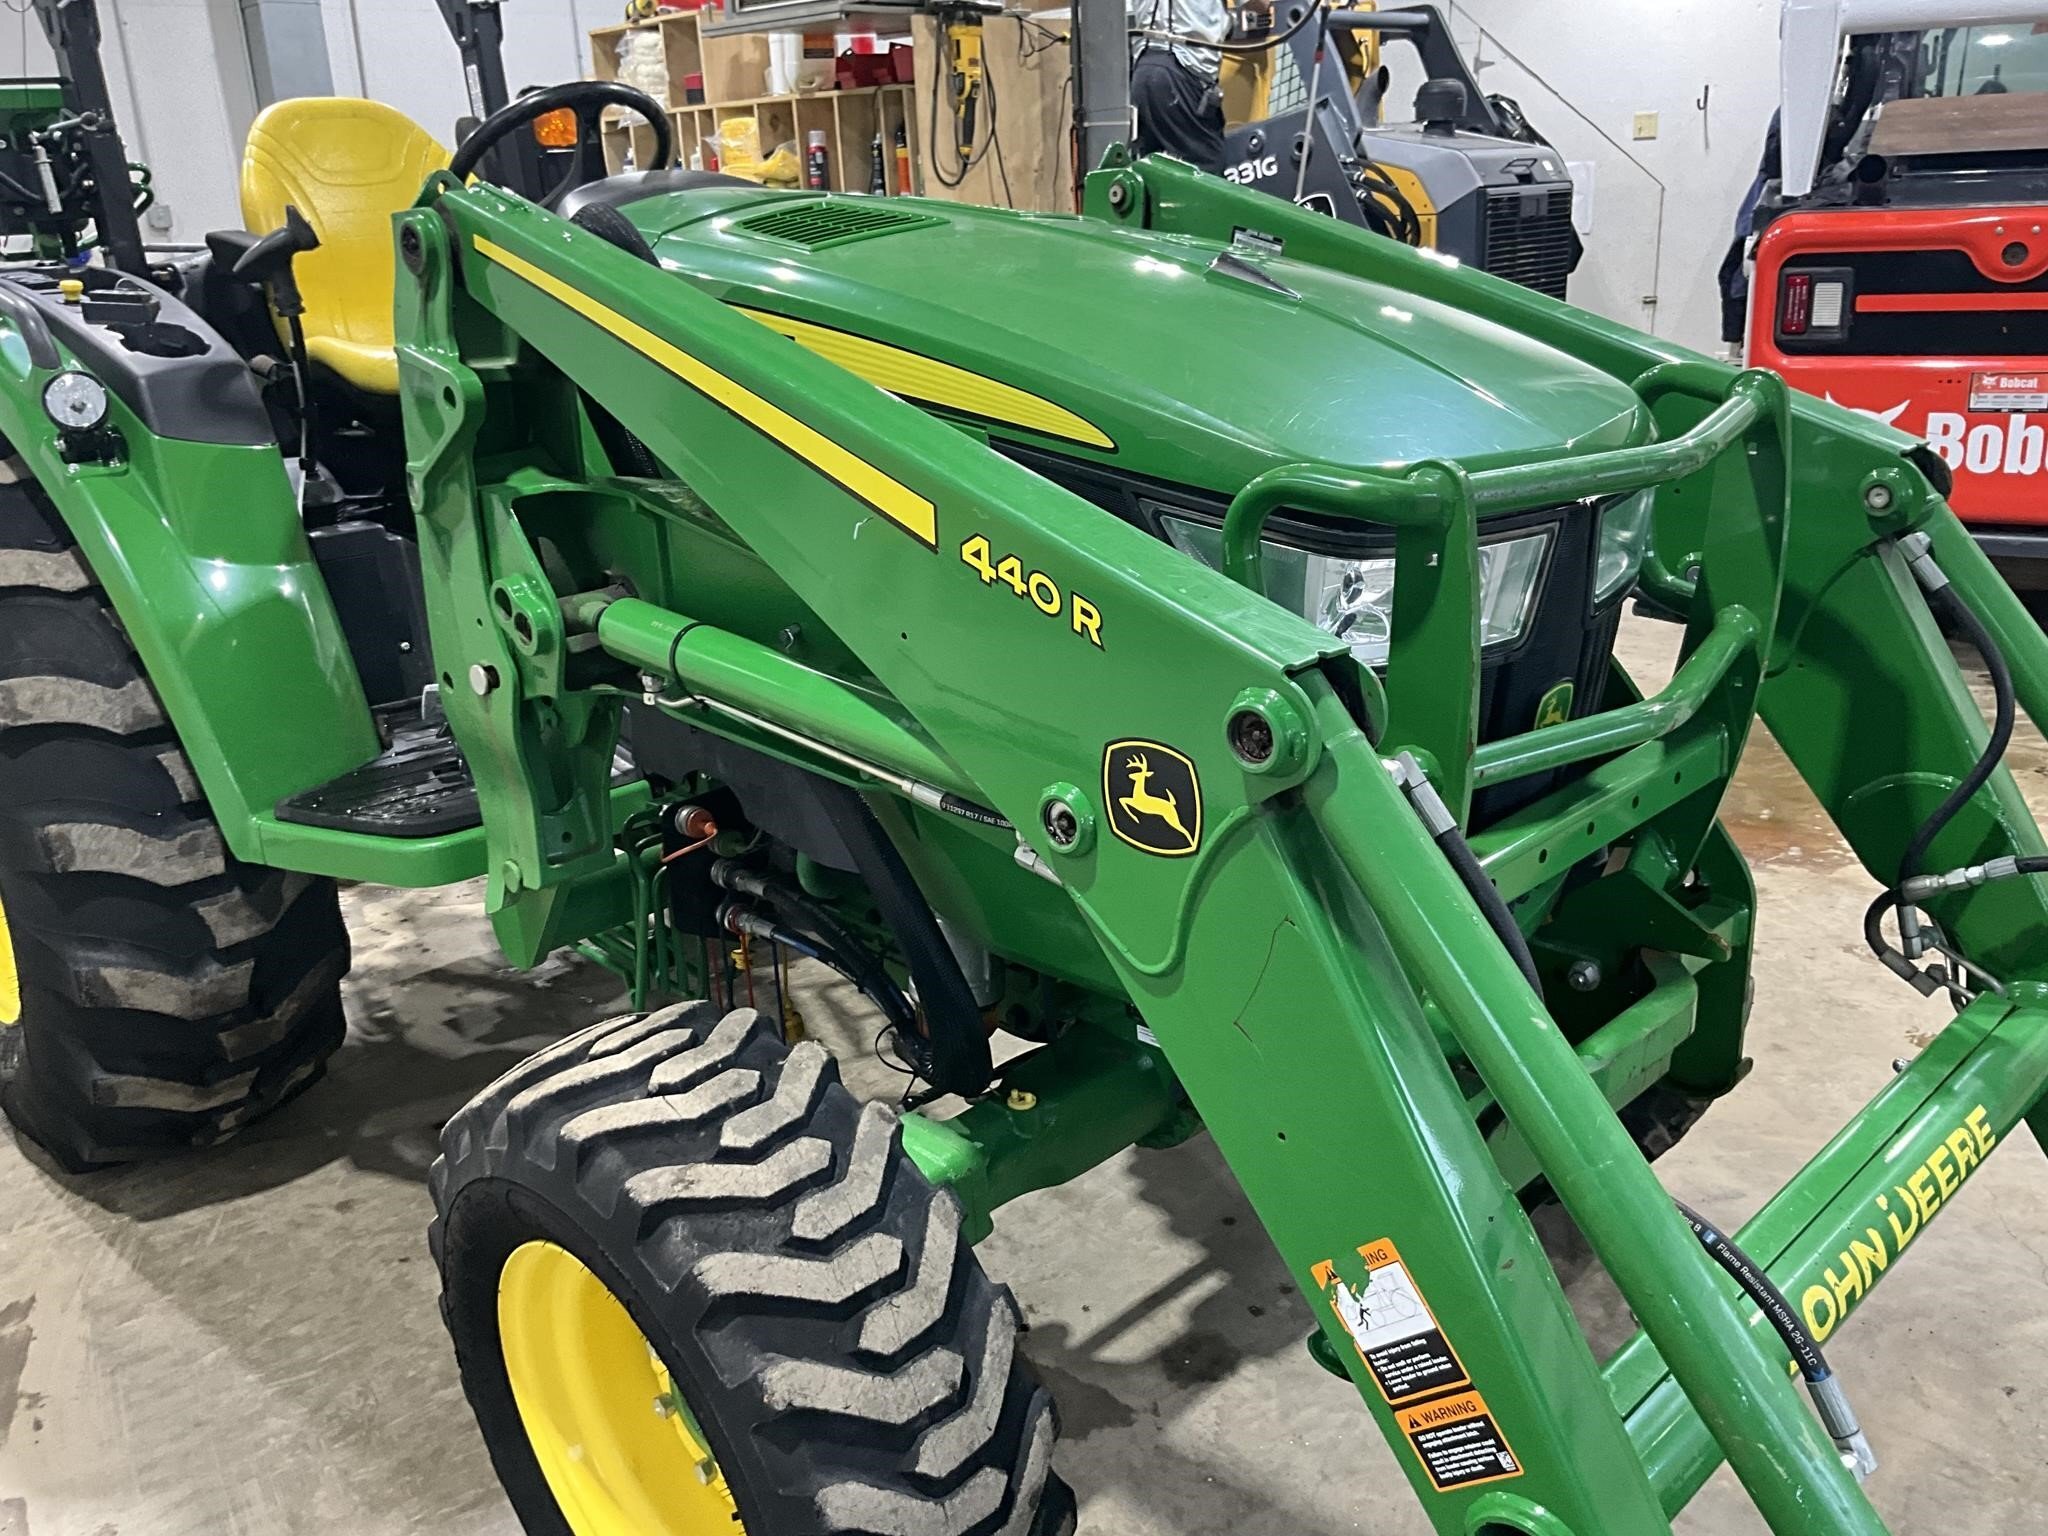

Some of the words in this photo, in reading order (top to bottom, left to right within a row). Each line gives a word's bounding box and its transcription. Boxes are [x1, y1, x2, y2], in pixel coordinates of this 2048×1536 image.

[1223, 157, 1278, 184] 331G
[1926, 412, 2048, 475] Bob
[960, 533, 1063, 618] 440
[1071, 590, 1105, 651] R
[1716, 1243, 1741, 1268] Flame
[1740, 1266, 1775, 1306] Resistant
[1773, 1304, 1795, 1331] MSHA
[1791, 1330, 1817, 1366] 2G-11C
[1790, 1227, 1888, 1375] OHN
[1421, 1401, 1476, 1423] WARNING
